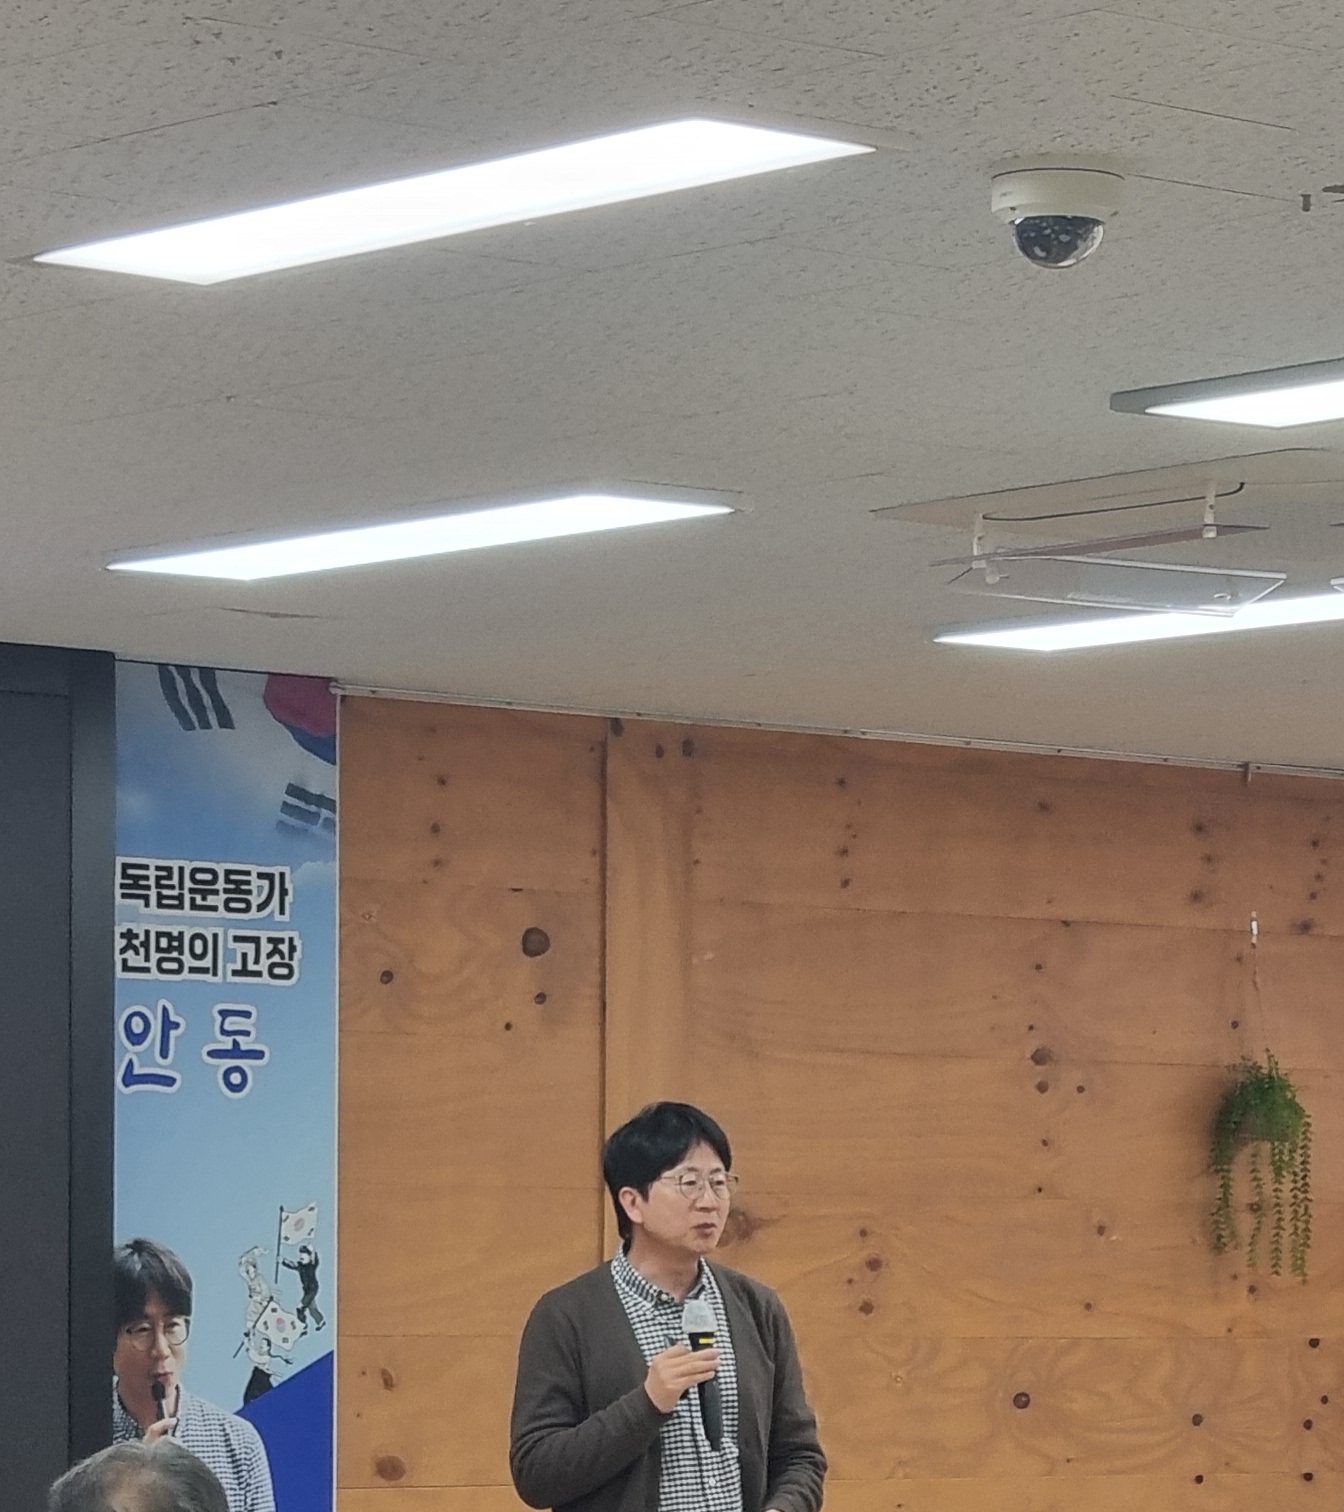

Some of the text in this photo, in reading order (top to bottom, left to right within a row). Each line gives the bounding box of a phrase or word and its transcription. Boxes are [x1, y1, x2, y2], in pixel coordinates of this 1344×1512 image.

[119, 861, 289, 916] 독립운동가
[119, 928, 297, 981] 천명의 고장
